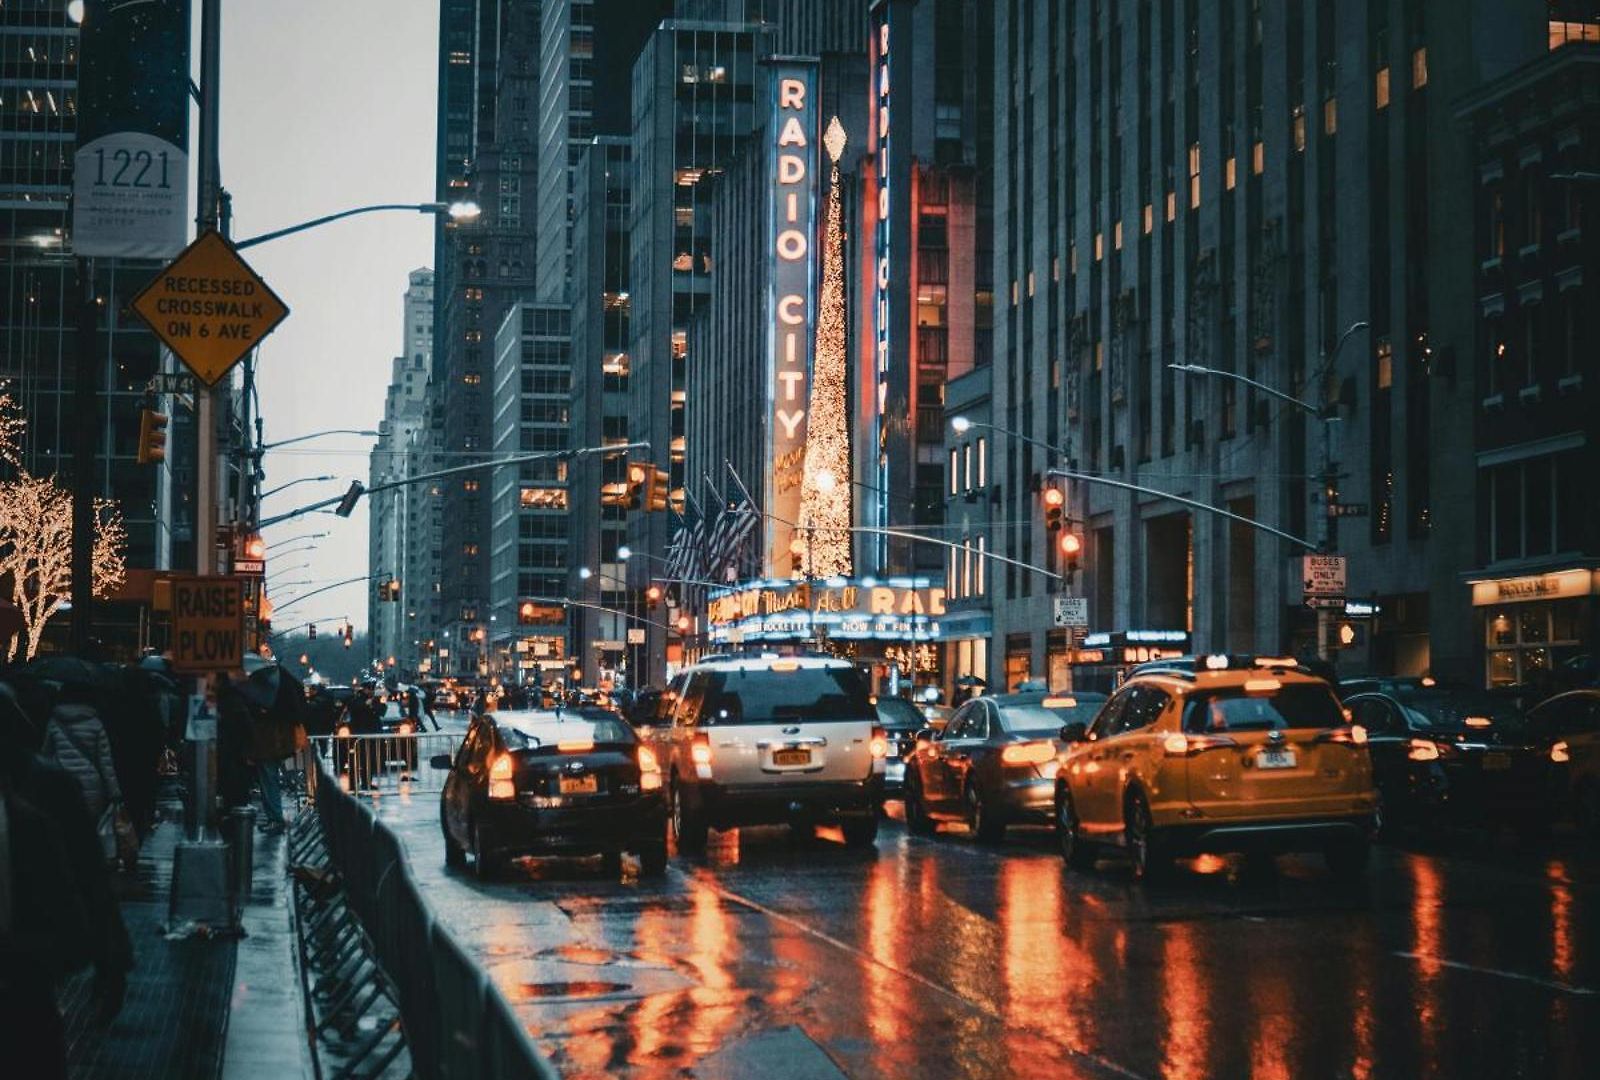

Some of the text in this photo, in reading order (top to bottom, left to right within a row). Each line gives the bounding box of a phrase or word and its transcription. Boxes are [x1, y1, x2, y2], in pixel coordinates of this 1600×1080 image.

[93, 148, 171, 189] 1221
[879, 23, 889, 415] RADIO CITY
[776, 78, 807, 440] RADIO CITY
[165, 277, 255, 296] RECESSED
[157, 299, 264, 319] CROSSWALK
[168, 321, 251, 339] ON 6 AVE
[1311, 557, 1340, 566] BUSES
[1313, 571, 1336, 580] ONLY
[176, 587, 237, 617] RAISE
[842, 621, 868, 632] NOW
[893, 622, 925, 633] FINL
[179, 628, 237, 661] PLOW
